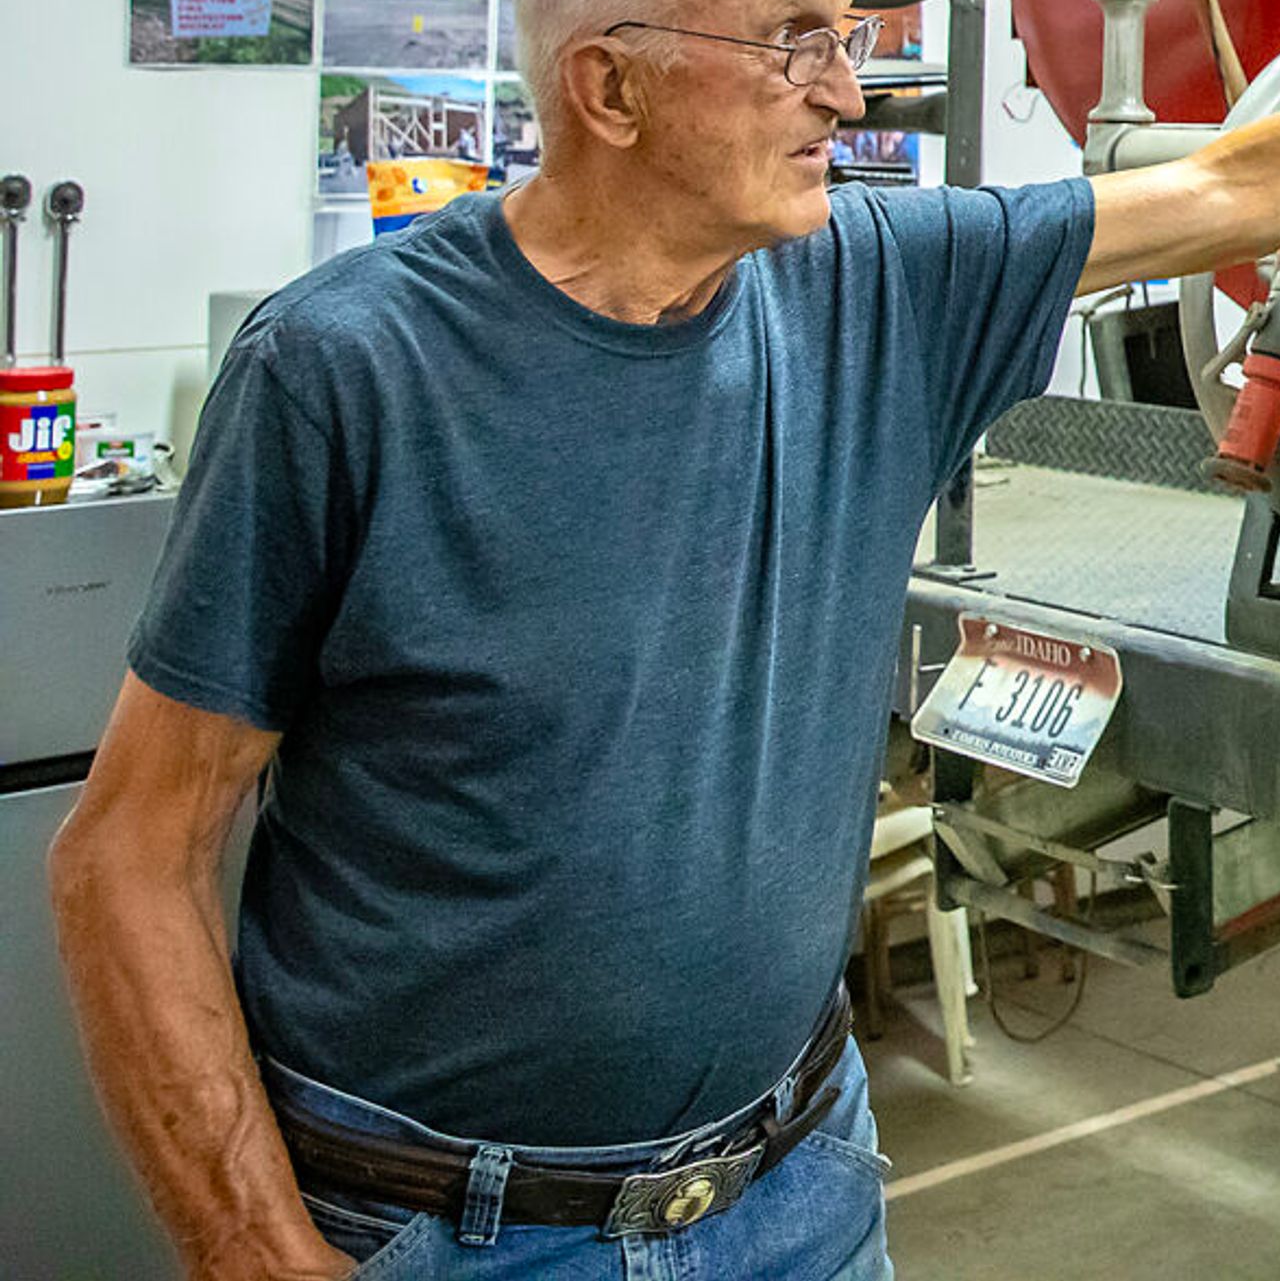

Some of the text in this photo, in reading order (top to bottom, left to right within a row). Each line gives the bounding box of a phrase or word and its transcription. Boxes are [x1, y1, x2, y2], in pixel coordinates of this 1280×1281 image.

[8, 415, 71, 452] Jif
[1016, 634, 1071, 667] IDAHO
[959, 658, 1084, 738] F 3106
